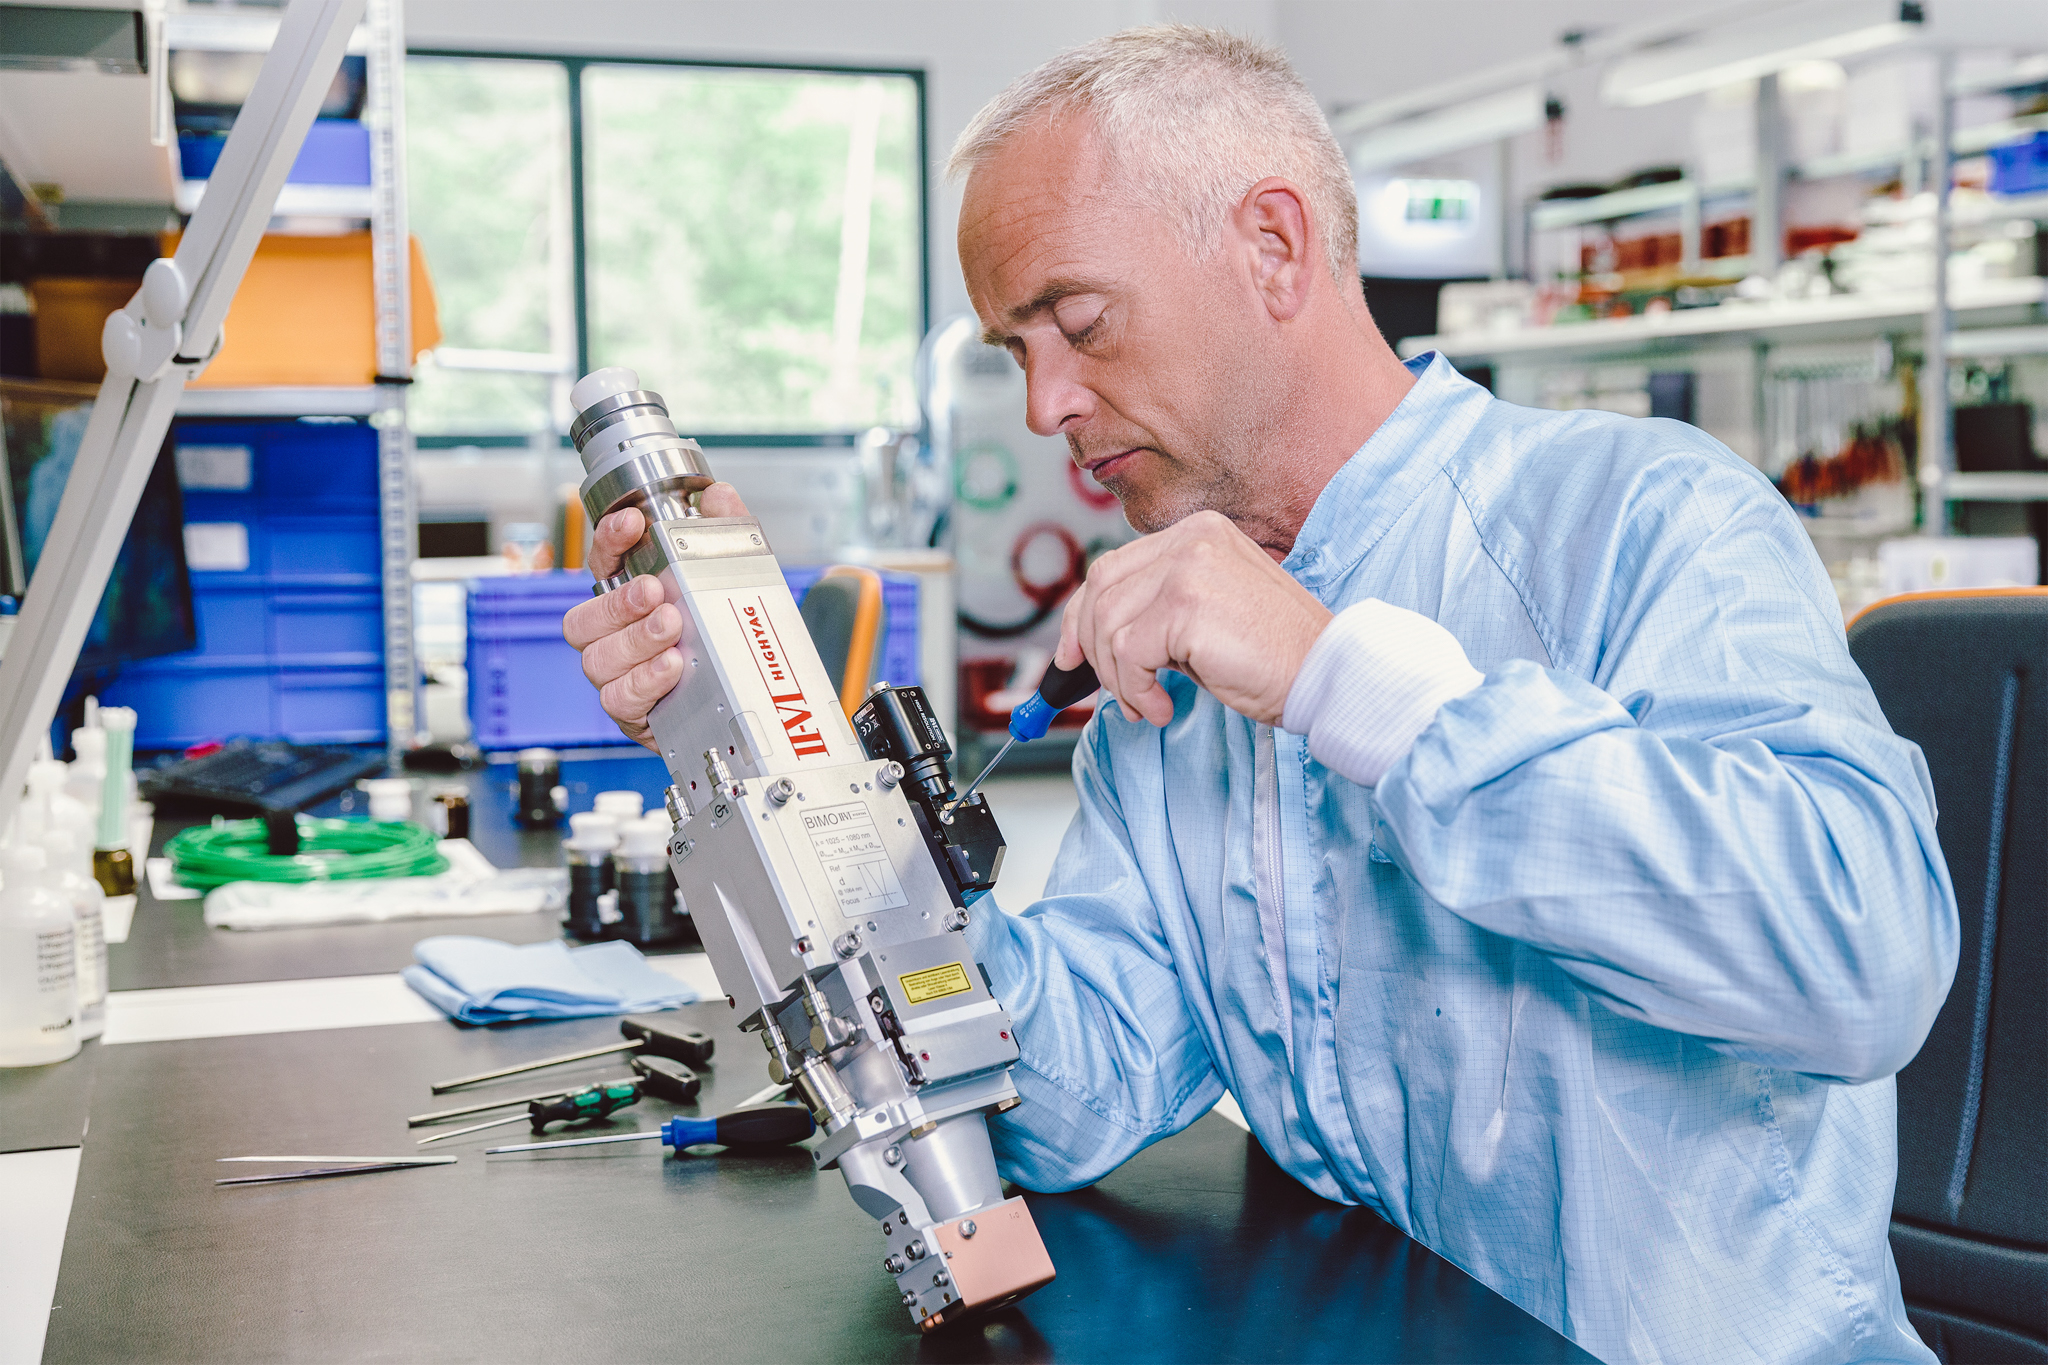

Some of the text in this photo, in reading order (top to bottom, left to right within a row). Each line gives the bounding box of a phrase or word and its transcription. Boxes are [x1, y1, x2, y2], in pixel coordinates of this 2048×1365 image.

[743, 606, 830, 761] II-VI HIGHYAG
[804, 812, 838, 829] BIMO
[825, 836, 841, 845] 1025
[845, 833, 861, 842] 1080
[839, 876, 845, 886] d
[841, 897, 861, 906] Focus
